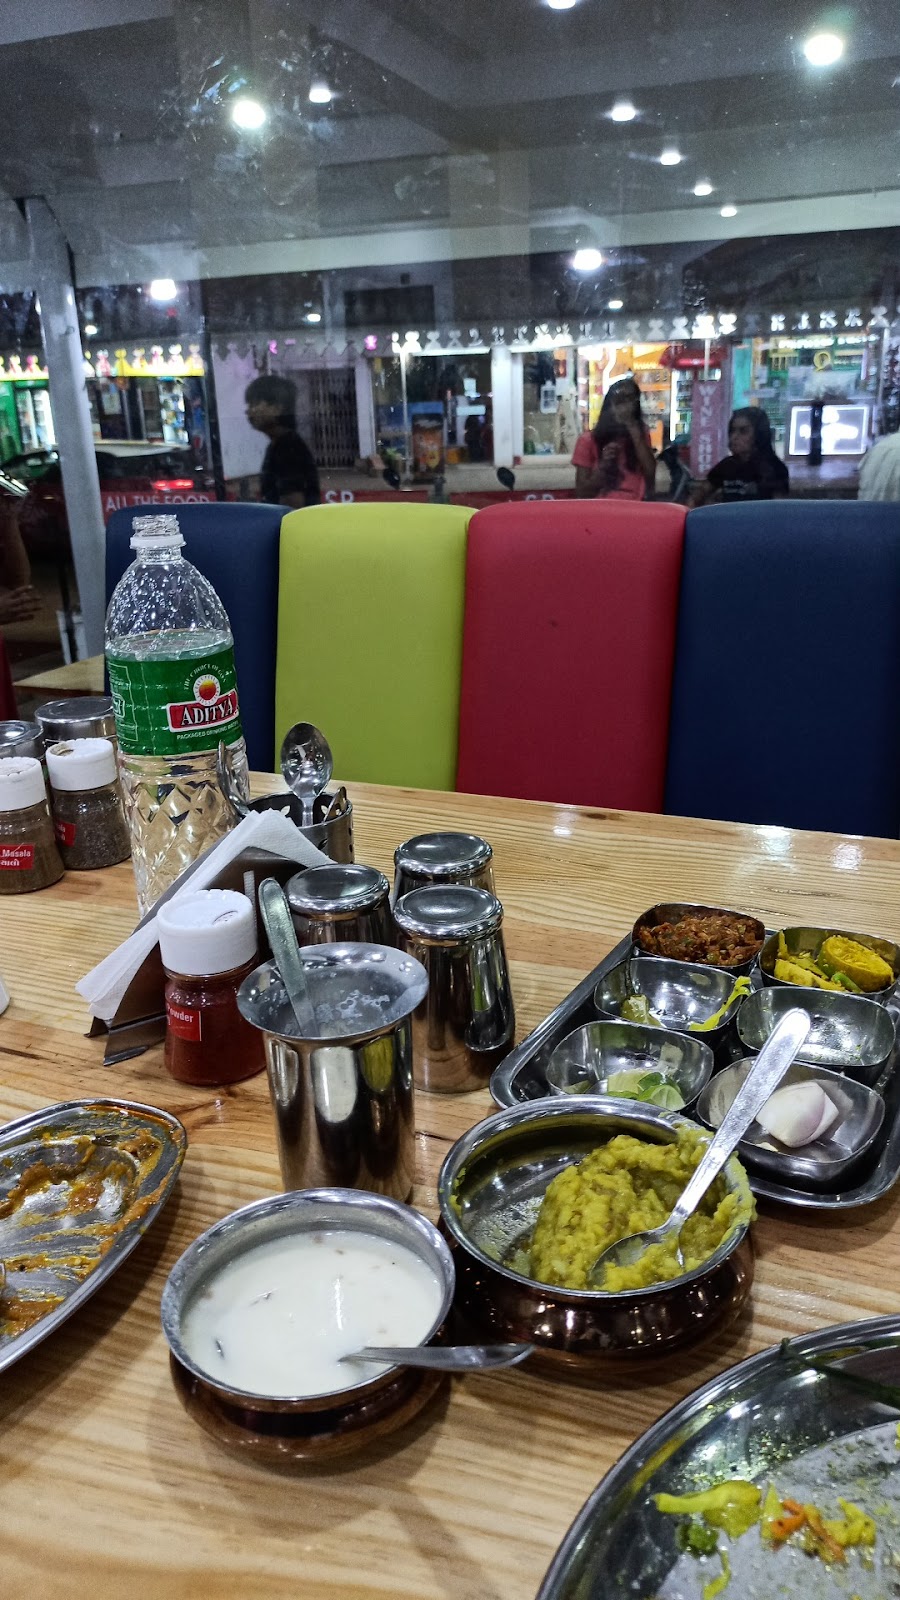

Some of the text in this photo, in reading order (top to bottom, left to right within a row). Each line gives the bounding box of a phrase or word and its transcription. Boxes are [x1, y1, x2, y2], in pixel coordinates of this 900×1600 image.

[698, 385, 717, 427] WINE
[181, 697, 233, 726] ADITYA
[176, 731, 206, 740] PACKAGED
[206, 725, 228, 736] DRINKING
[2, 849, 31, 857] Masala
